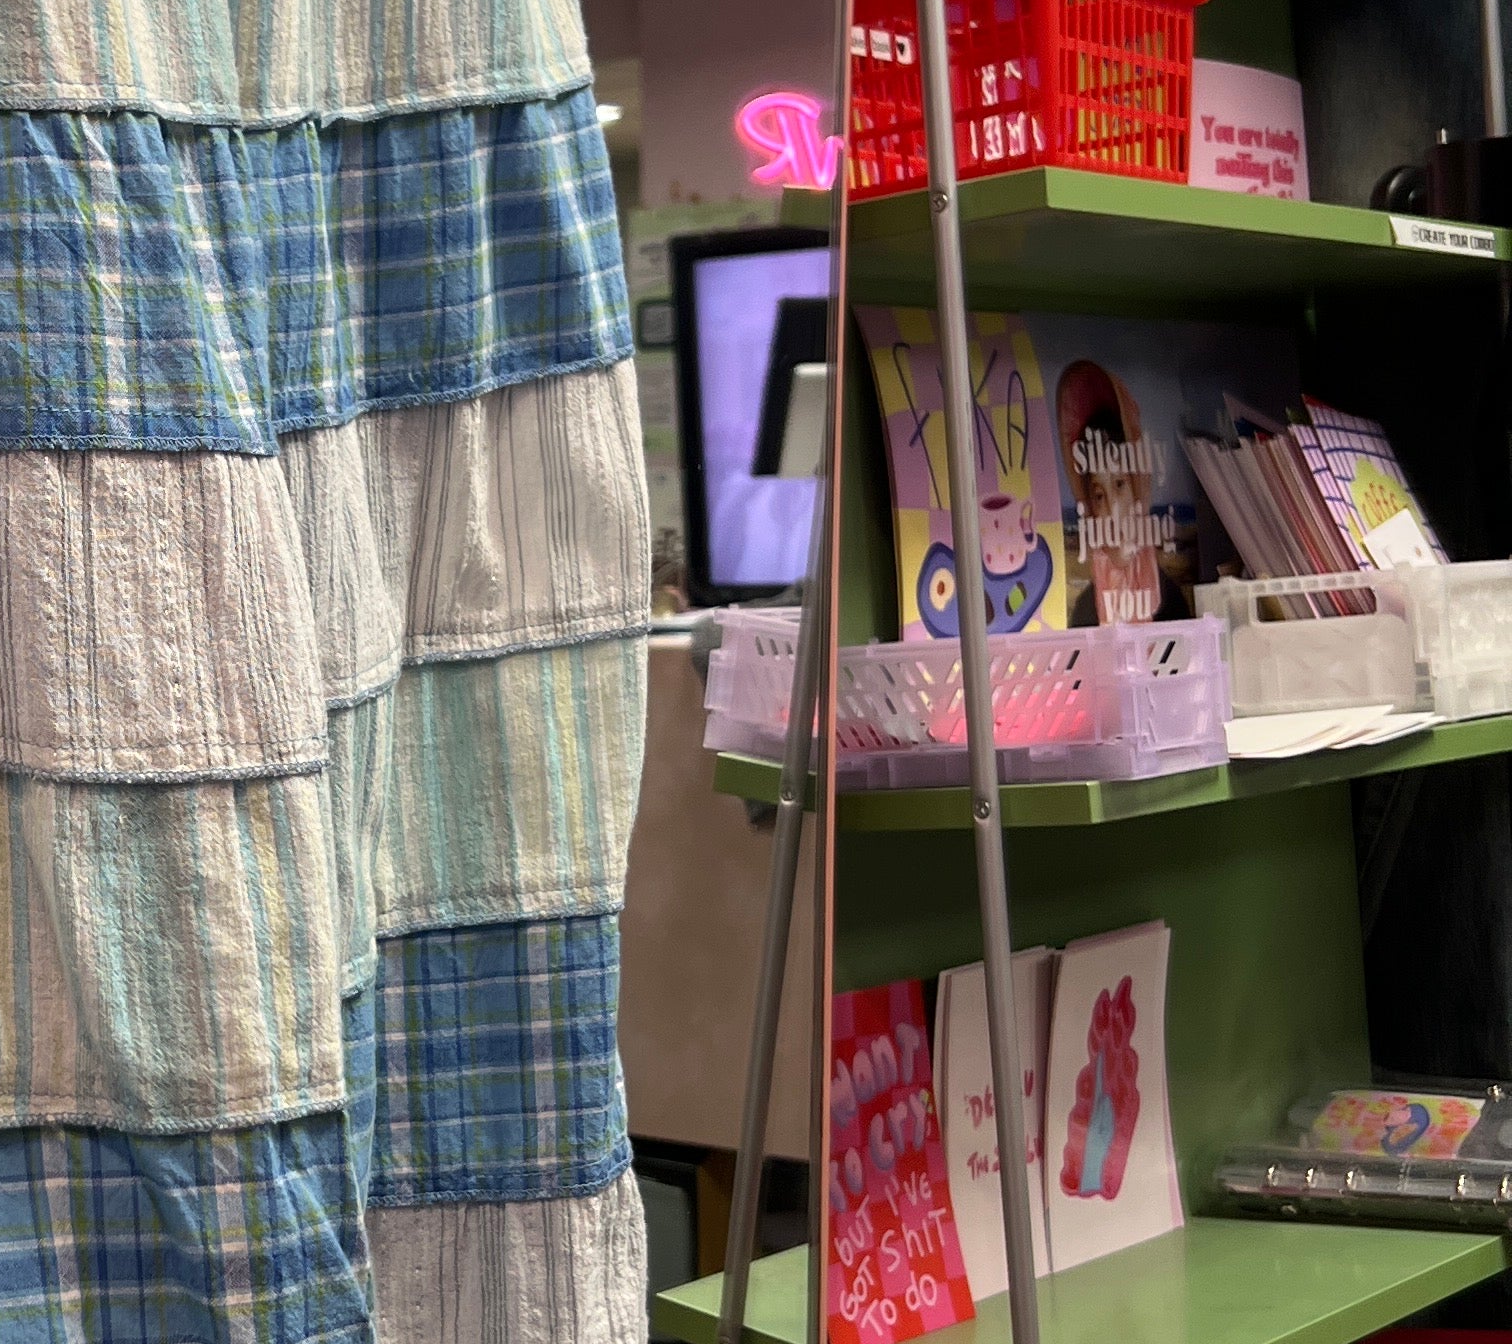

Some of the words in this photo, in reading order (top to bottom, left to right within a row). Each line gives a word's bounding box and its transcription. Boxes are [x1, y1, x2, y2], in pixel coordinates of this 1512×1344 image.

[893, 342, 1029, 512] FKA
[1072, 426, 1170, 488] silently
[1076, 501, 1178, 565] judging
[1101, 587, 1155, 628] you
